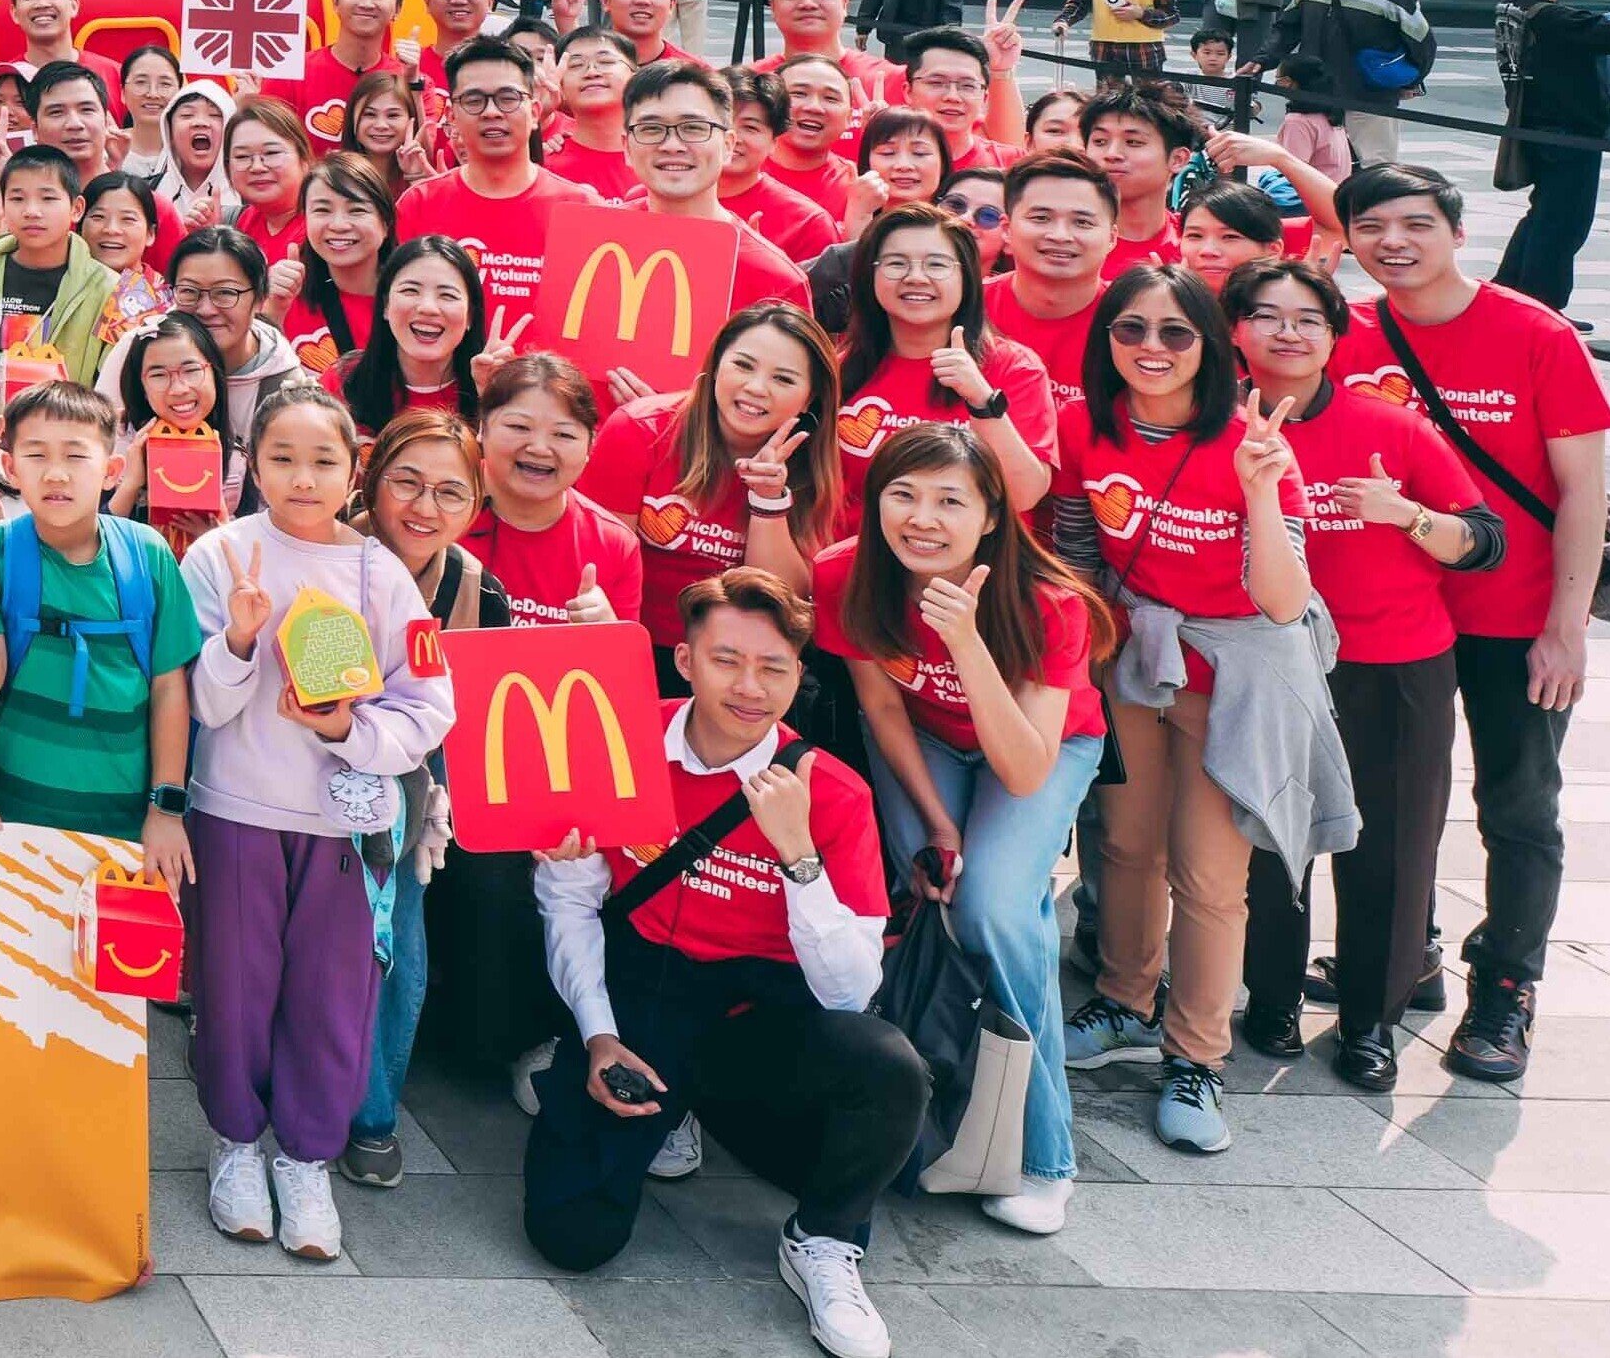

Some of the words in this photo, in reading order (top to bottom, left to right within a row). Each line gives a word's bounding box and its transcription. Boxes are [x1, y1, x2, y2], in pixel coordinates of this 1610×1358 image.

[489, 283, 531, 297] Team
[1135, 494, 1239, 524] McDonald's
[1149, 514, 1237, 541] Volunteer
[1308, 515, 1364, 532] Team
[1149, 530, 1196, 555] Team
[693, 858, 781, 895] olunteer
